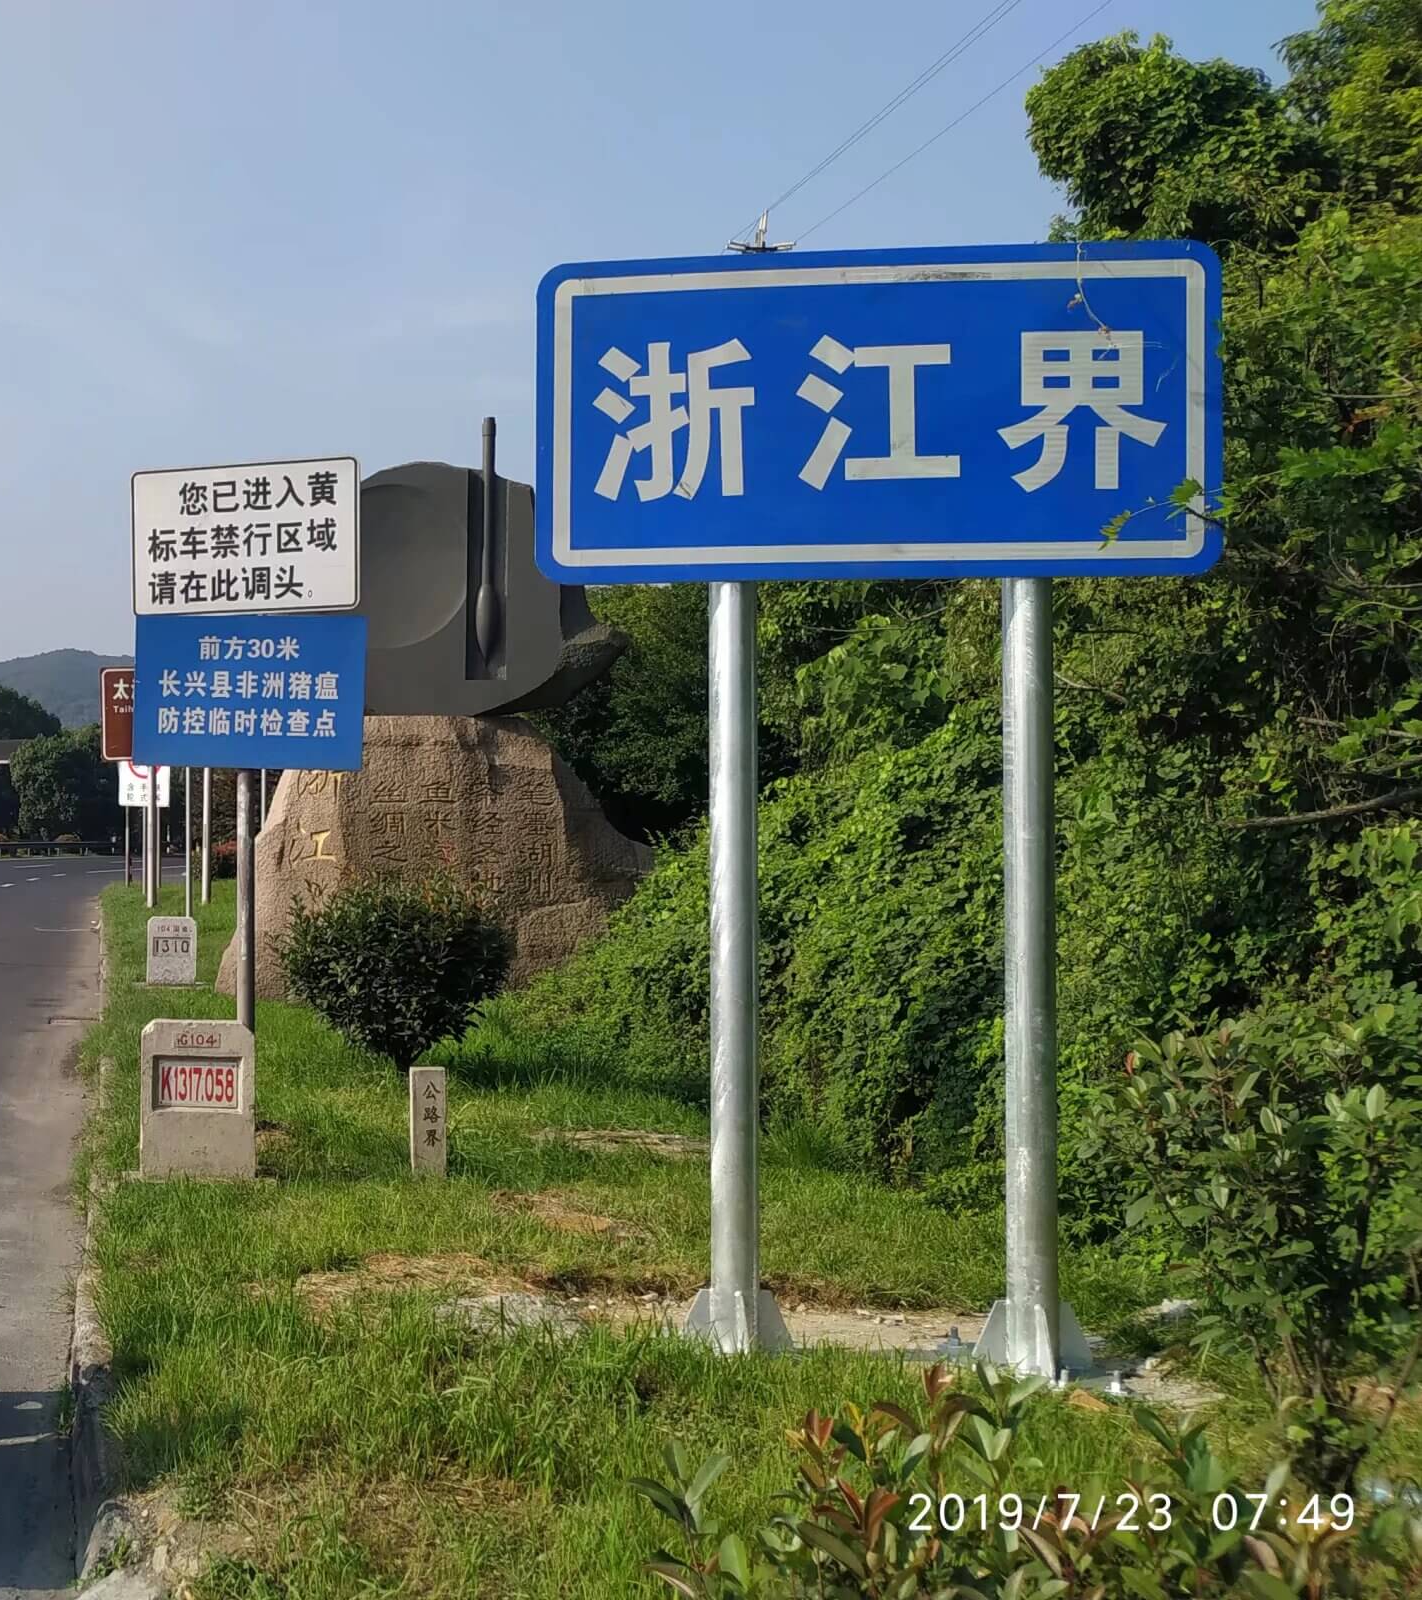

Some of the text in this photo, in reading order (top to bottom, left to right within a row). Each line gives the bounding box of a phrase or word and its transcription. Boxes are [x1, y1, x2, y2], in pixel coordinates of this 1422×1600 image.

[591, 329, 1168, 503] 浙江界
[178, 471, 339, 516] 您已进入黄
[147, 517, 338, 564] 标车禁行区域
[198, 635, 300, 662] 前方30米
[158, 670, 340, 701] 长兴县非洲猪瘟
[157, 706, 338, 738] 防控临时检查点
[155, 939, 190, 953] 1310
[160, 1066, 235, 1103] K1317.058
[422, 1080, 441, 1148] 公路界
